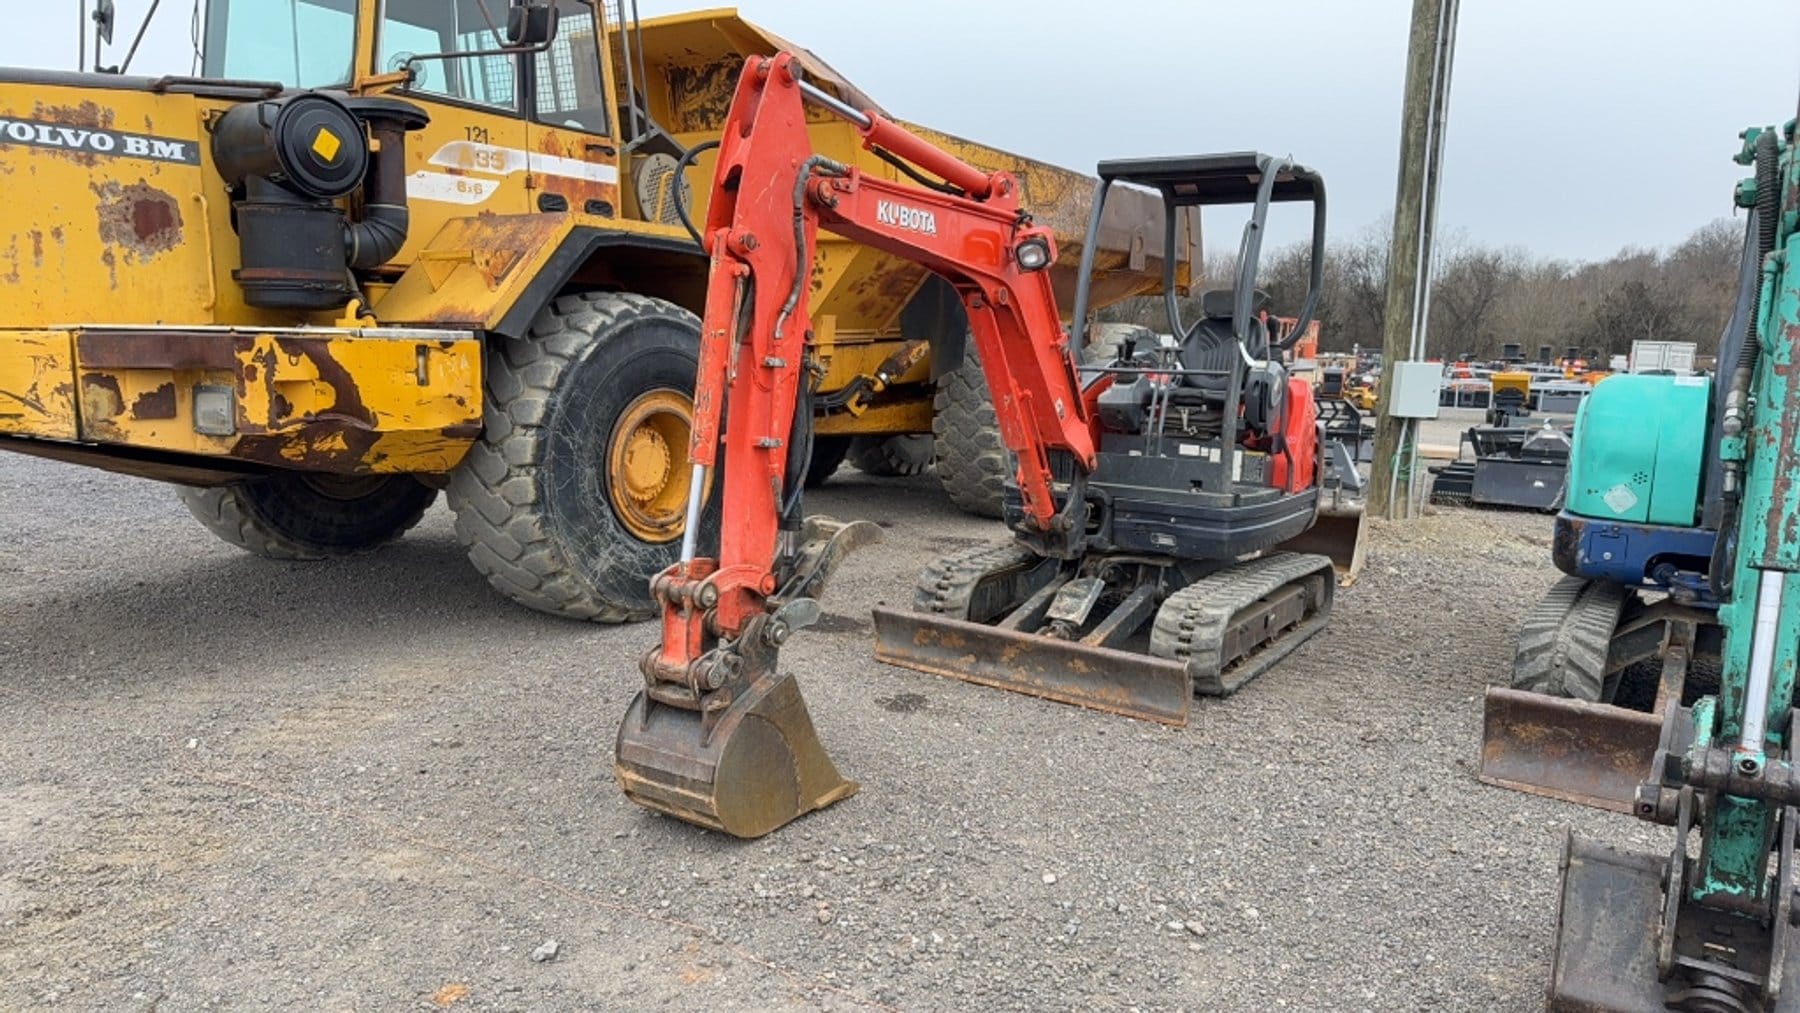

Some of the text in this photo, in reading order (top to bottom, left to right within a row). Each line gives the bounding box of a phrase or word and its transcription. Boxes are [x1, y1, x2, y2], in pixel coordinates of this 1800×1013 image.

[0, 120, 186, 161] OLVO BM
[457, 146, 506, 171] A35
[876, 199, 937, 235] KUBOTA
